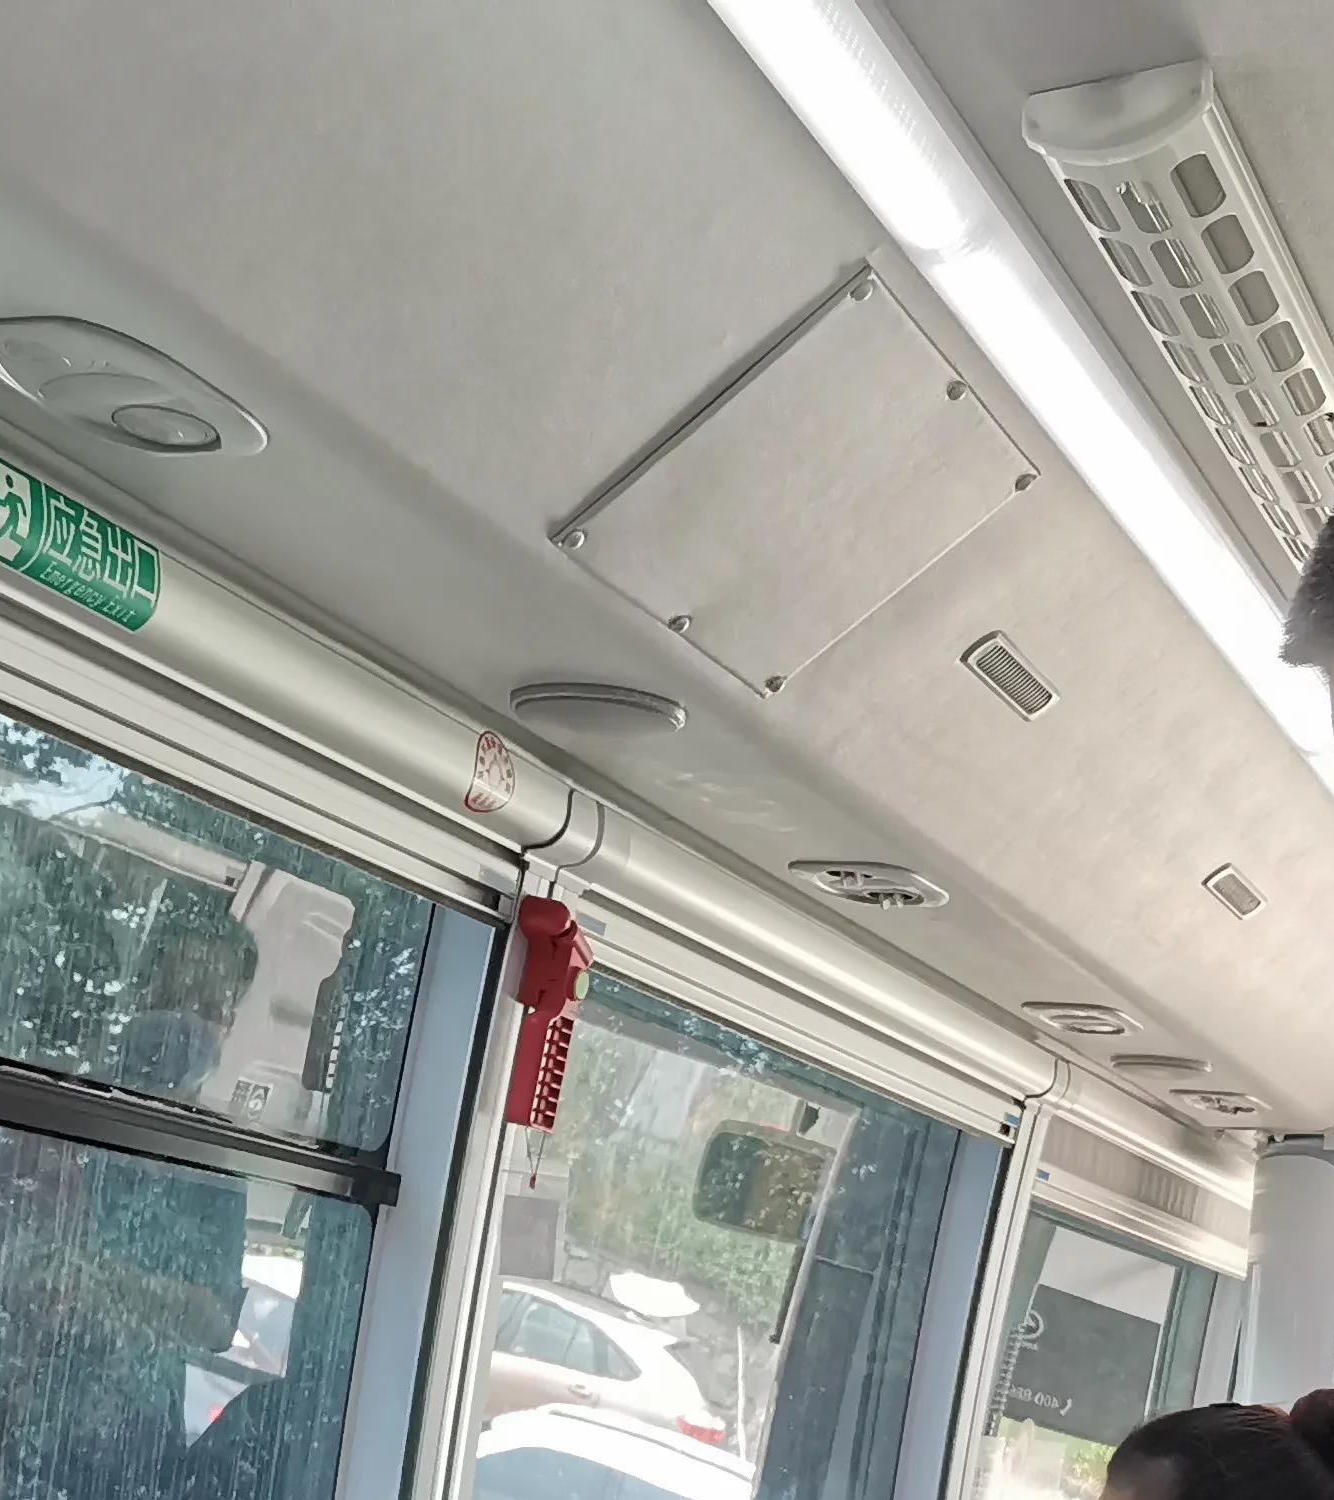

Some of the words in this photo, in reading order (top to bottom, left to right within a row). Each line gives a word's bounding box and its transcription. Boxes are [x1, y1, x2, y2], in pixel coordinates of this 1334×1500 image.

[41, 562, 104, 608] Emergency
[103, 596, 138, 623] Exit
[43, 496, 159, 608] 应急出口
